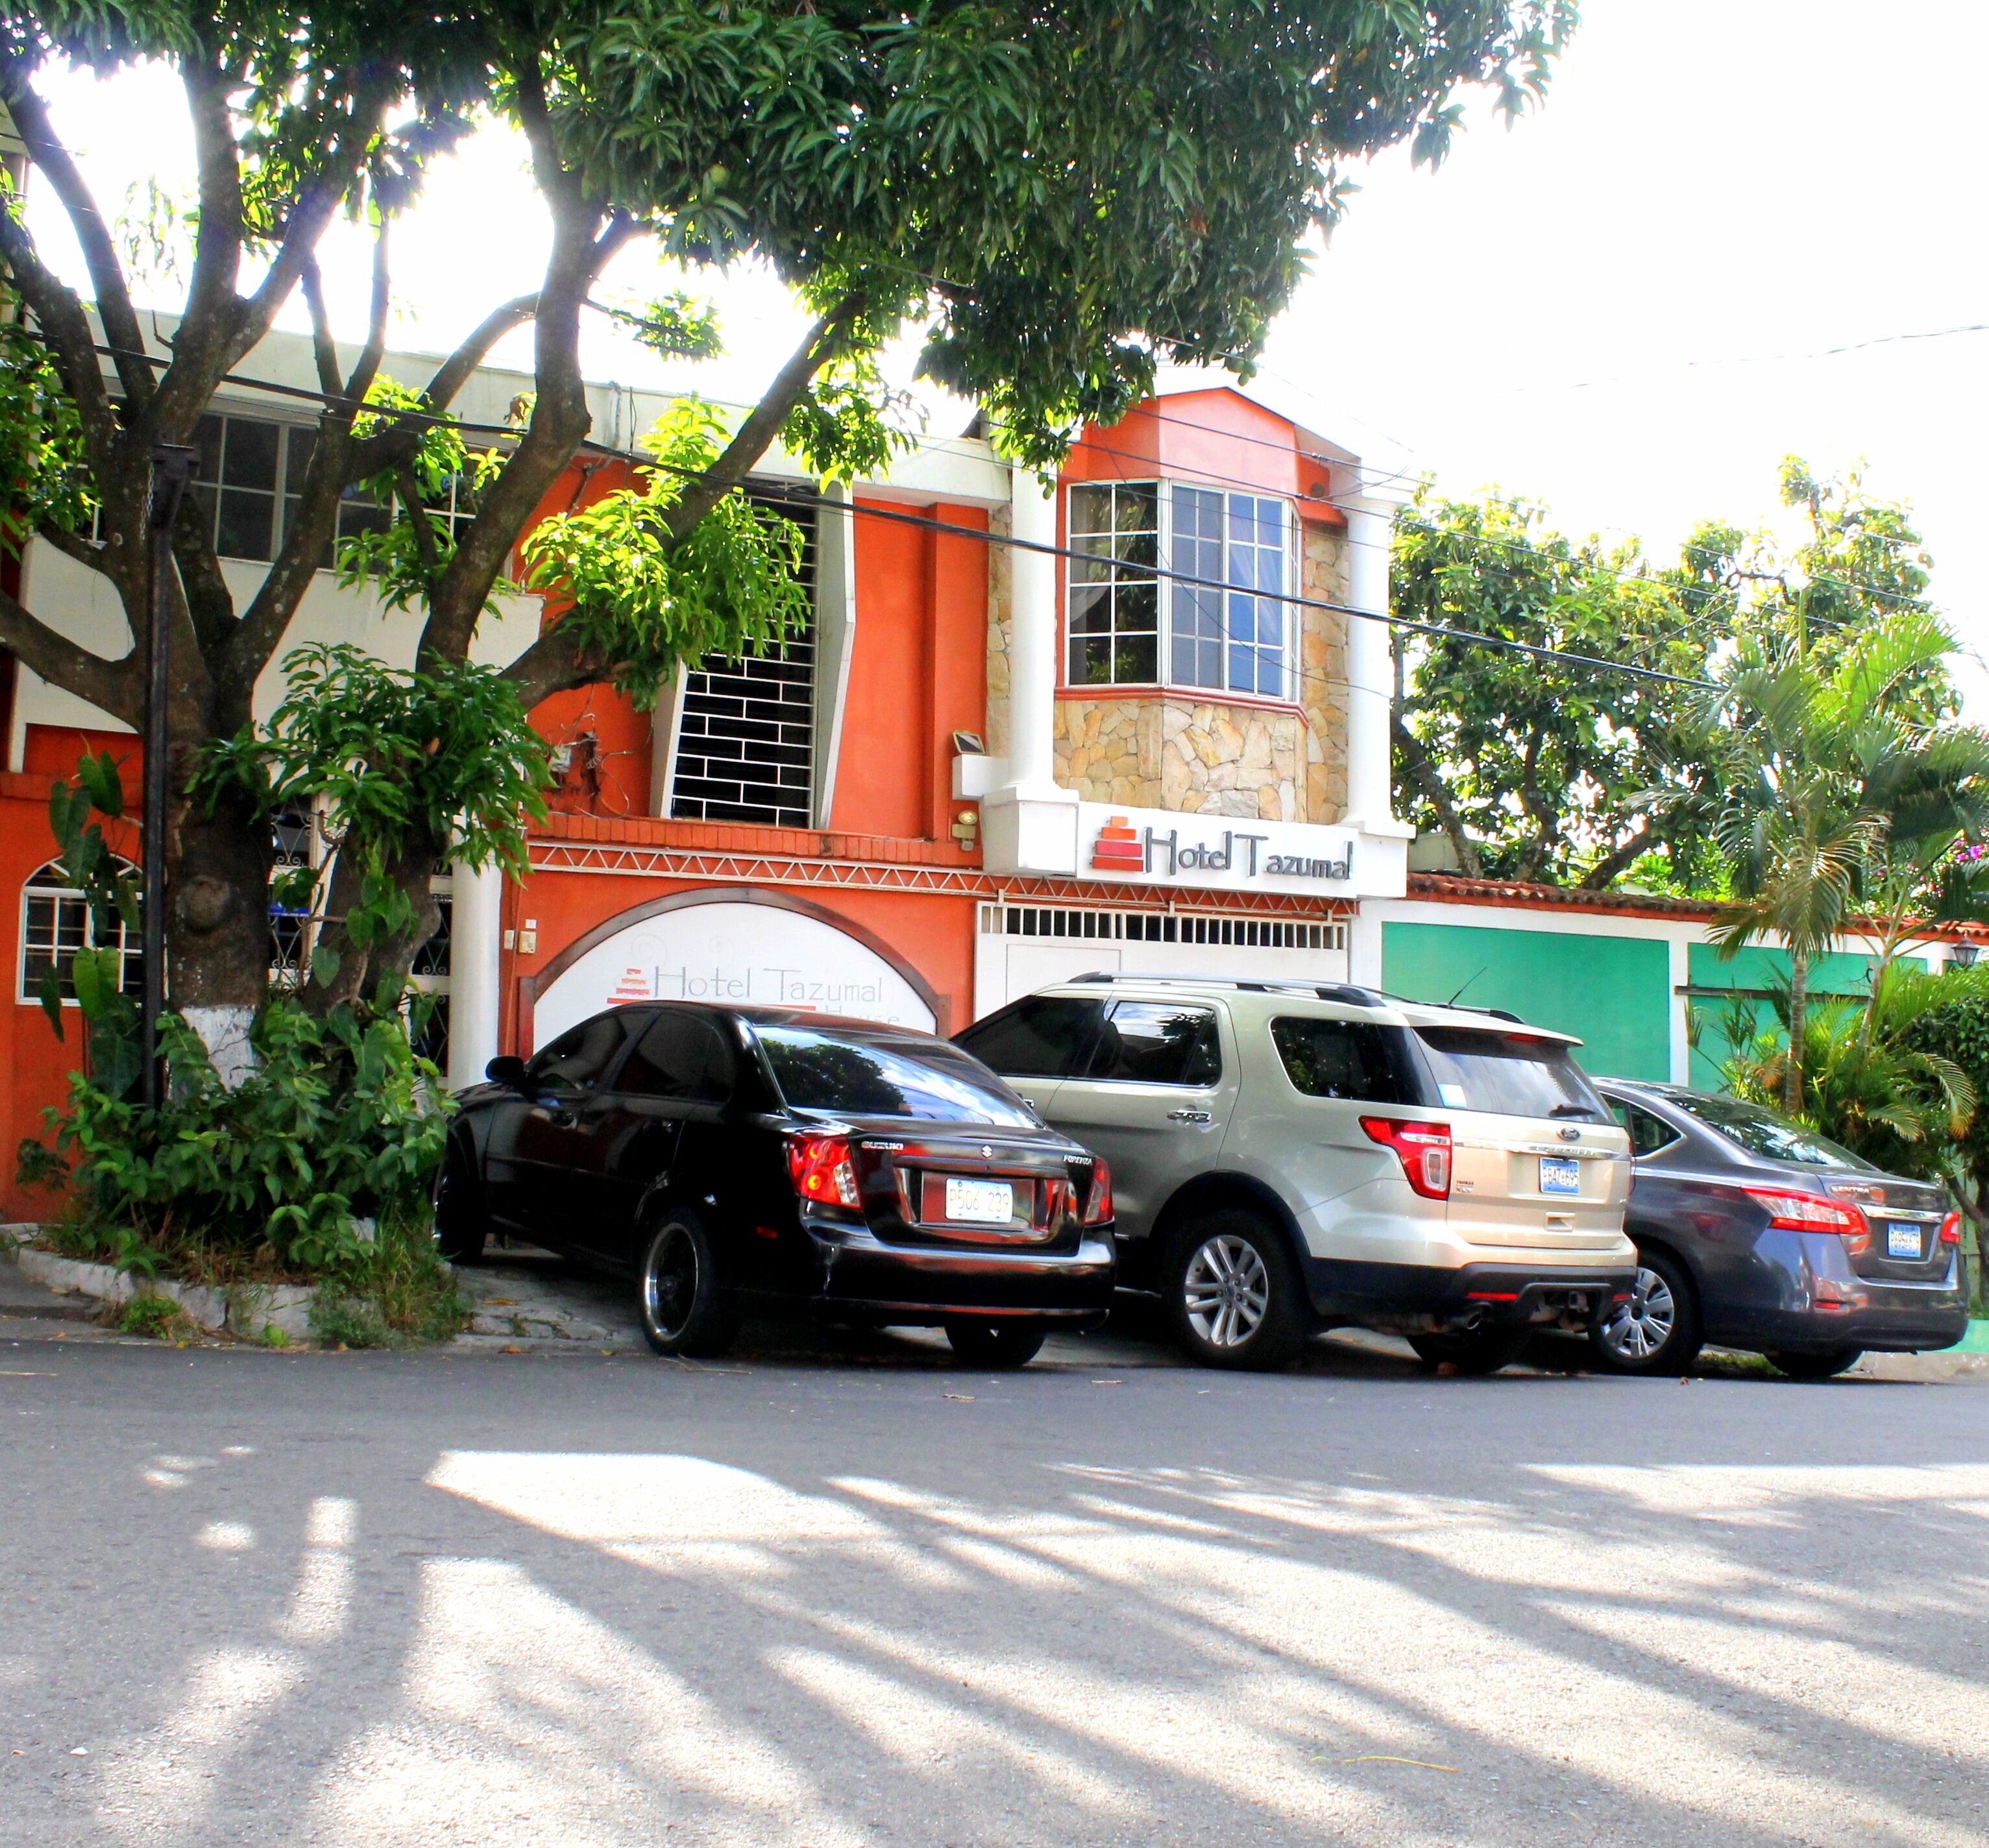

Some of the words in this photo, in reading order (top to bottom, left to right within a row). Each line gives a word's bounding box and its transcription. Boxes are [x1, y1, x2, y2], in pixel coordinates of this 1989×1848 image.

[1145, 826, 1232, 876] Hotel
[1234, 833, 1354, 881] Tazumal
[654, 966, 750, 999] Hotel
[763, 968, 882, 1003] Tazumal
[949, 1188, 979, 1210] P506
[988, 1191, 1009, 1213] 239
[1831, 1185, 1870, 1194] SENTRA
